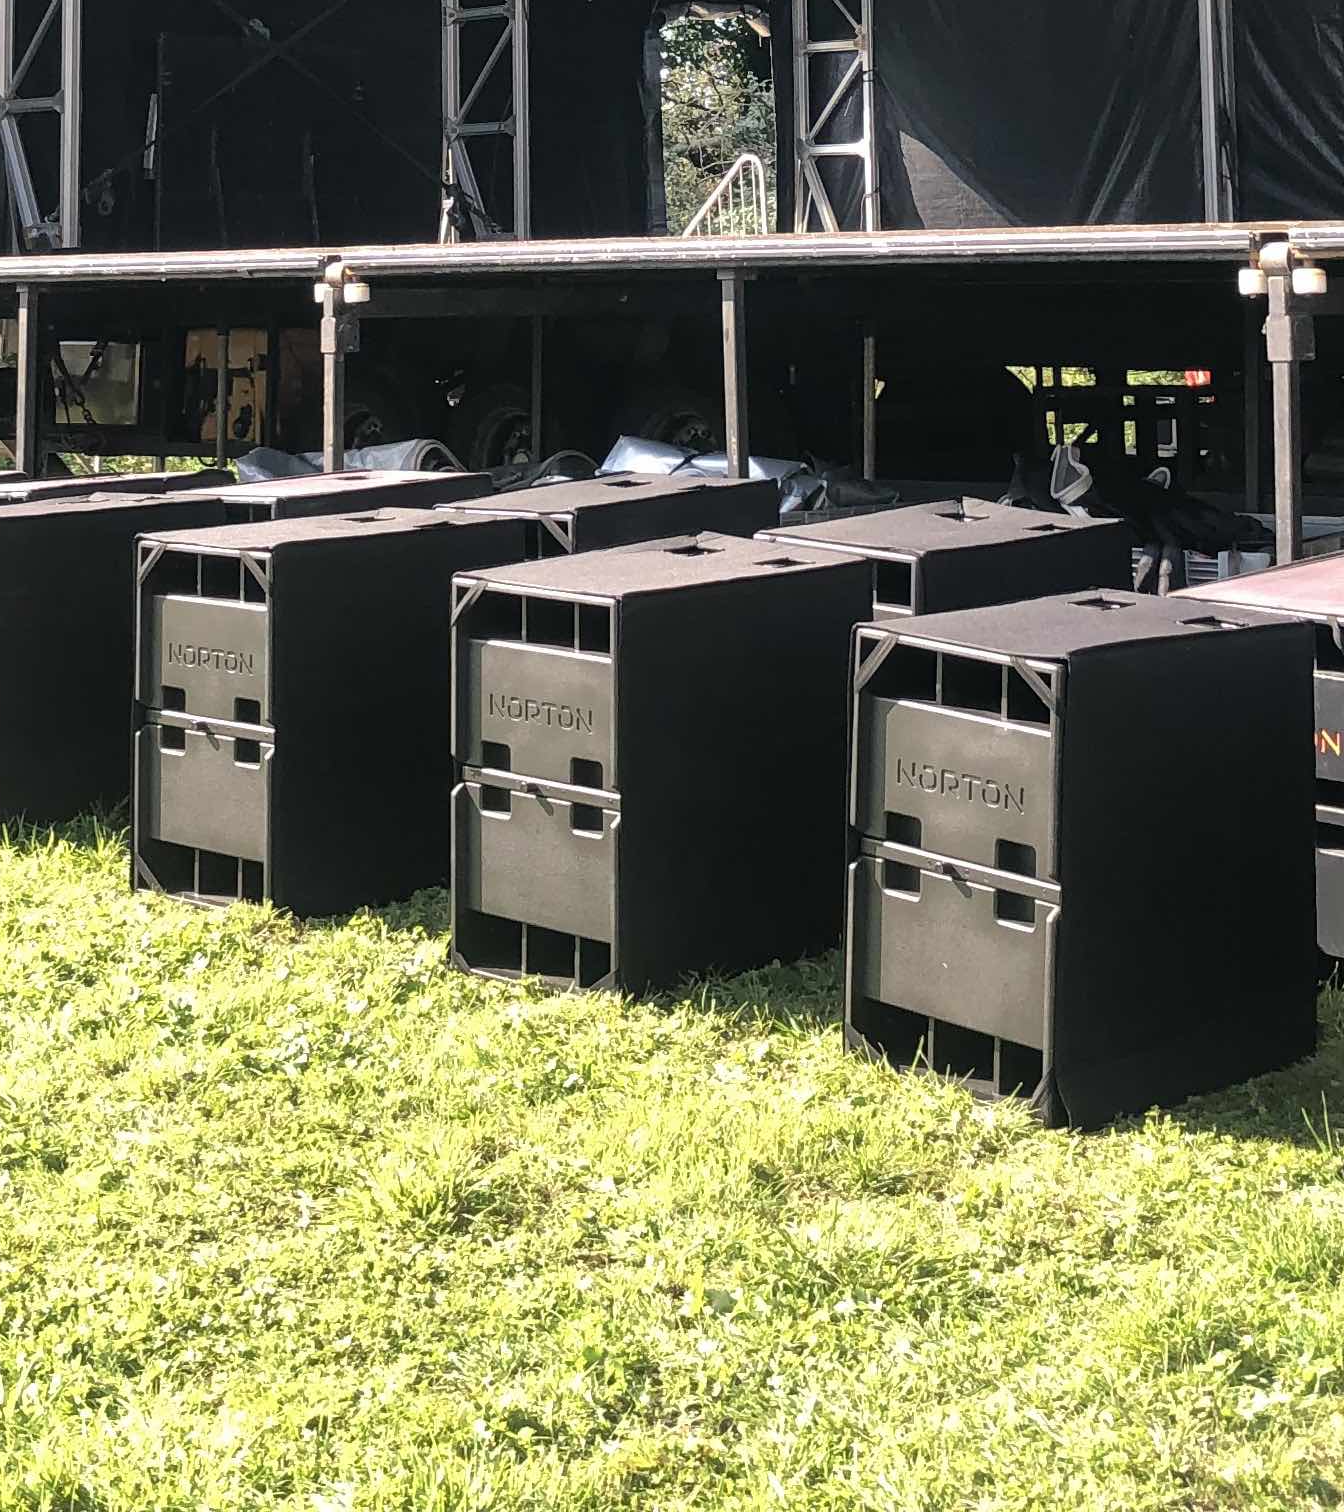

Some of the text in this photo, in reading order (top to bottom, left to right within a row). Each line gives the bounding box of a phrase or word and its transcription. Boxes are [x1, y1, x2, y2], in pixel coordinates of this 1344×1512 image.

[168, 642, 255, 677] NORTON
[489, 693, 594, 735] NORTON
[896, 758, 1025, 816] NORTON
